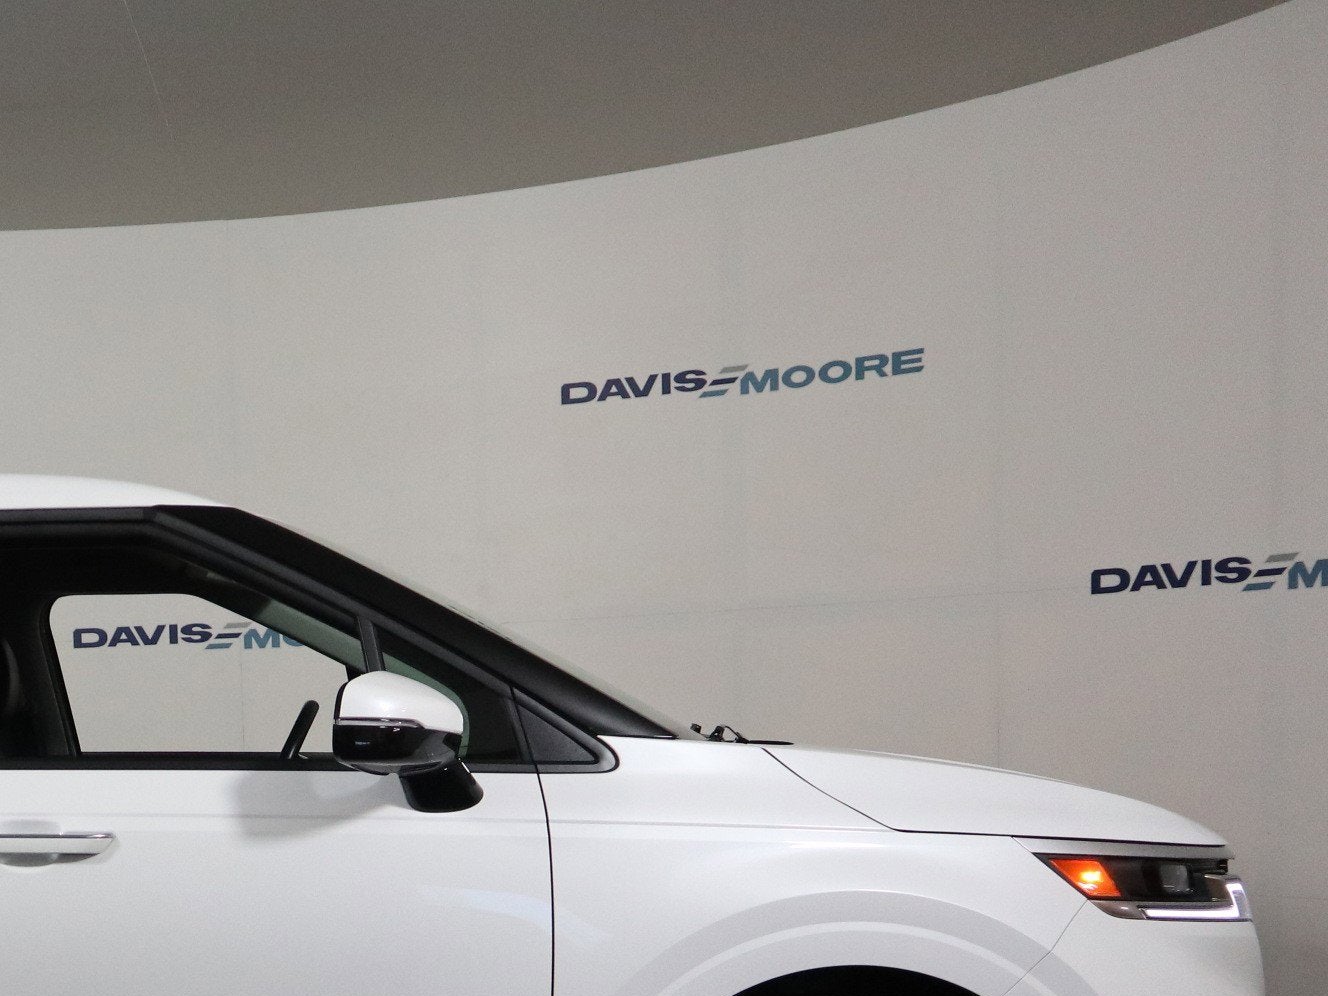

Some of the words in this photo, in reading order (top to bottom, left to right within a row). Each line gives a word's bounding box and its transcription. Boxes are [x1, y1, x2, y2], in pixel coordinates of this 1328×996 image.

[560, 369, 708, 405] DAVIS
[740, 347, 925, 395] MOORE
[1091, 557, 1252, 595] DAVIS
[72, 623, 214, 650] DAVIS
